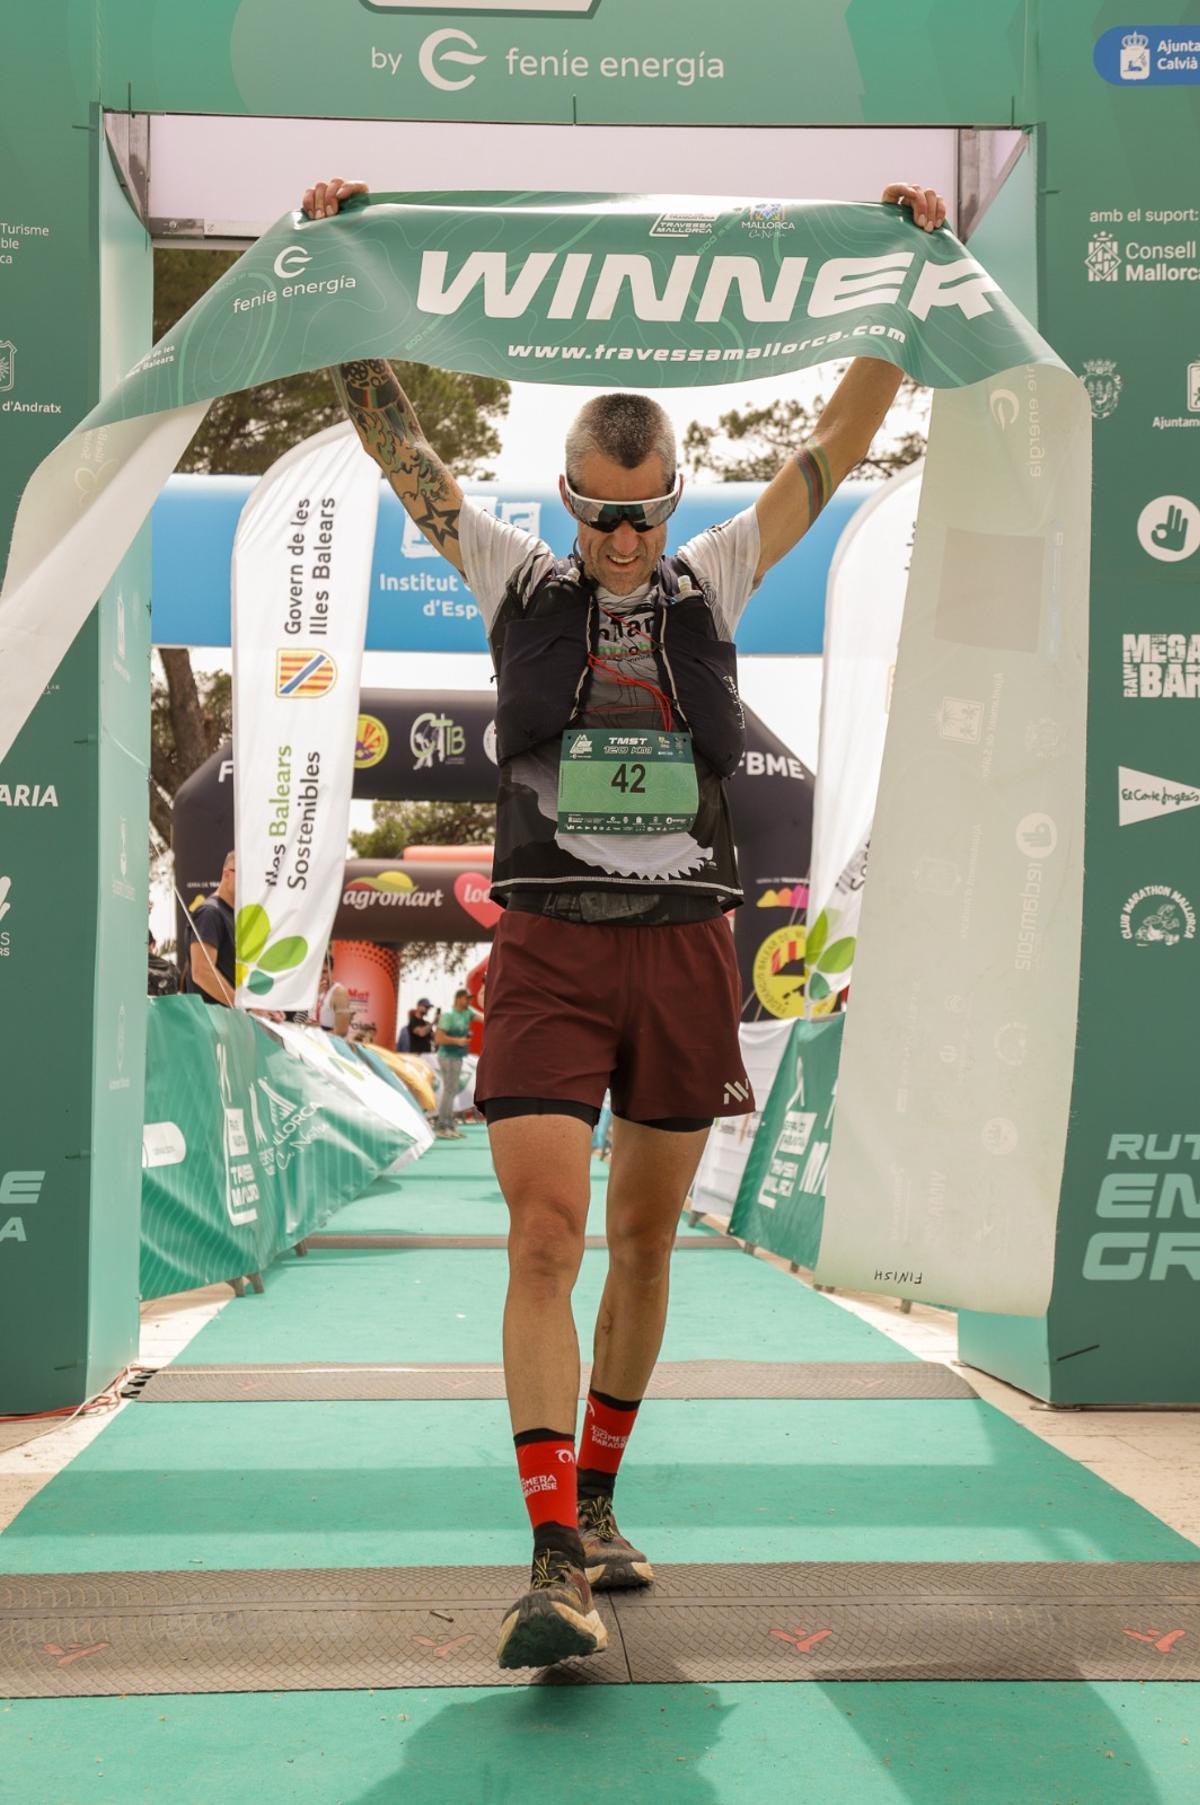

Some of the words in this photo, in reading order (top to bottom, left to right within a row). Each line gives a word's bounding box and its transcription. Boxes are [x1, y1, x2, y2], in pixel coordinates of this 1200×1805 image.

[371, 46, 402, 74] by
[506, 47, 589, 77] feníe
[599, 50, 725, 87] energía
[1157, 56, 1198, 70] Calvià
[741, 221, 796, 231] MALLORCA
[1090, 208, 1124, 222] amb
[1127, 208, 1141, 222] el
[1145, 208, 1200, 225] suport:
[0, 222, 49, 237] Turisme
[1125, 240, 1196, 260] Consell
[1125, 263, 1200, 281] Mallorc
[507, 324, 906, 362] www.travessamallorca.com
[2, 401, 62, 414] d'Andratx
[290, 498, 310, 527] les
[287, 533, 305, 556] de
[312, 497, 336, 579] Balears
[379, 572, 459, 591] Institut
[284, 563, 304, 635] Govern
[422, 600, 481, 620] d'Esp
[309, 590, 329, 635] Illes
[608, 736, 648, 746] TMST
[610, 763, 646, 794] 42
[268, 744, 292, 837] Balears
[287, 751, 321, 891] Sostenibles
[342, 888, 444, 910] agromart
[1122, 885, 1172, 914] MARATHON
[1170, 890, 1197, 939] MALLORCA
[1107, 1134, 1200, 1160] RUT
[873, 1269, 923, 1285] FINISH
